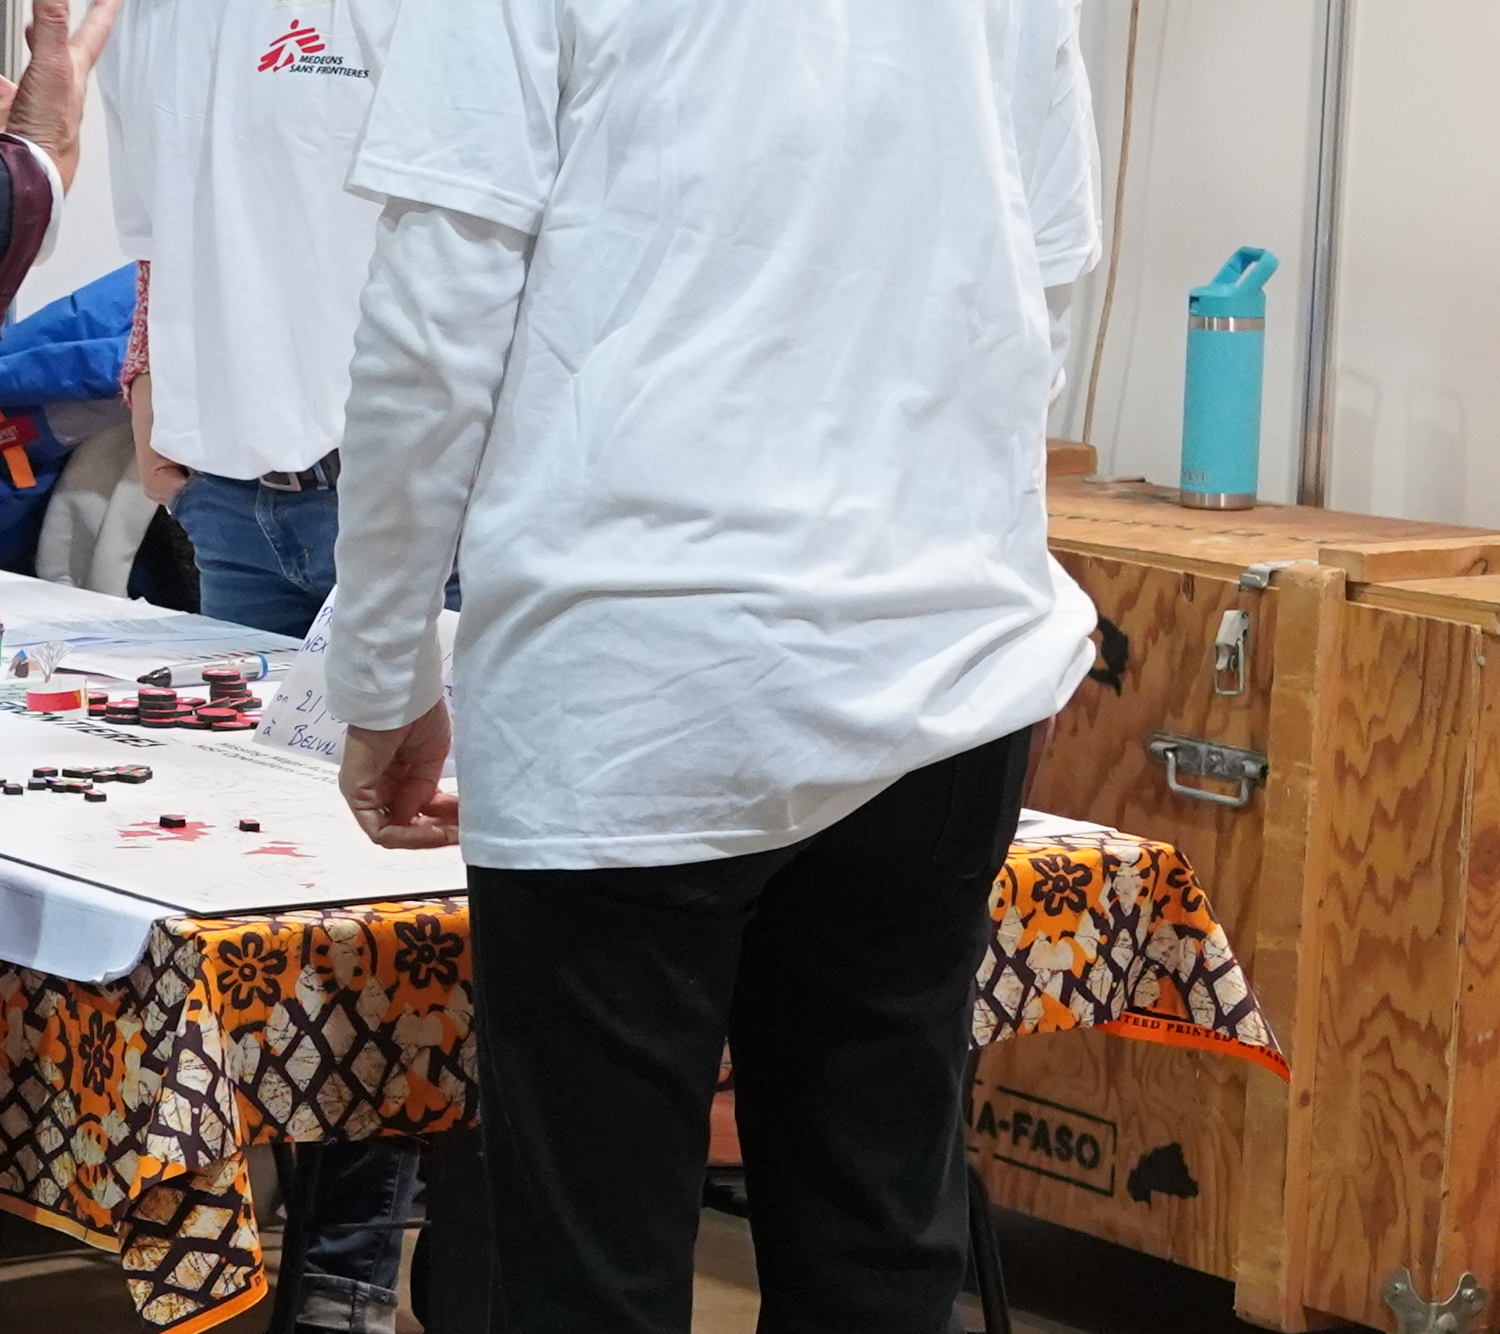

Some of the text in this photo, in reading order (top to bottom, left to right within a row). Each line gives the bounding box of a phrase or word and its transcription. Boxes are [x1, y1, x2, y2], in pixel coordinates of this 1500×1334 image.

[288, 63, 315, 74] SANS
[300, 634, 330, 654] NEX
[1166, 1023, 1232, 1043] PRINTED
[970, 1100, 1100, 1169] A-FASO
